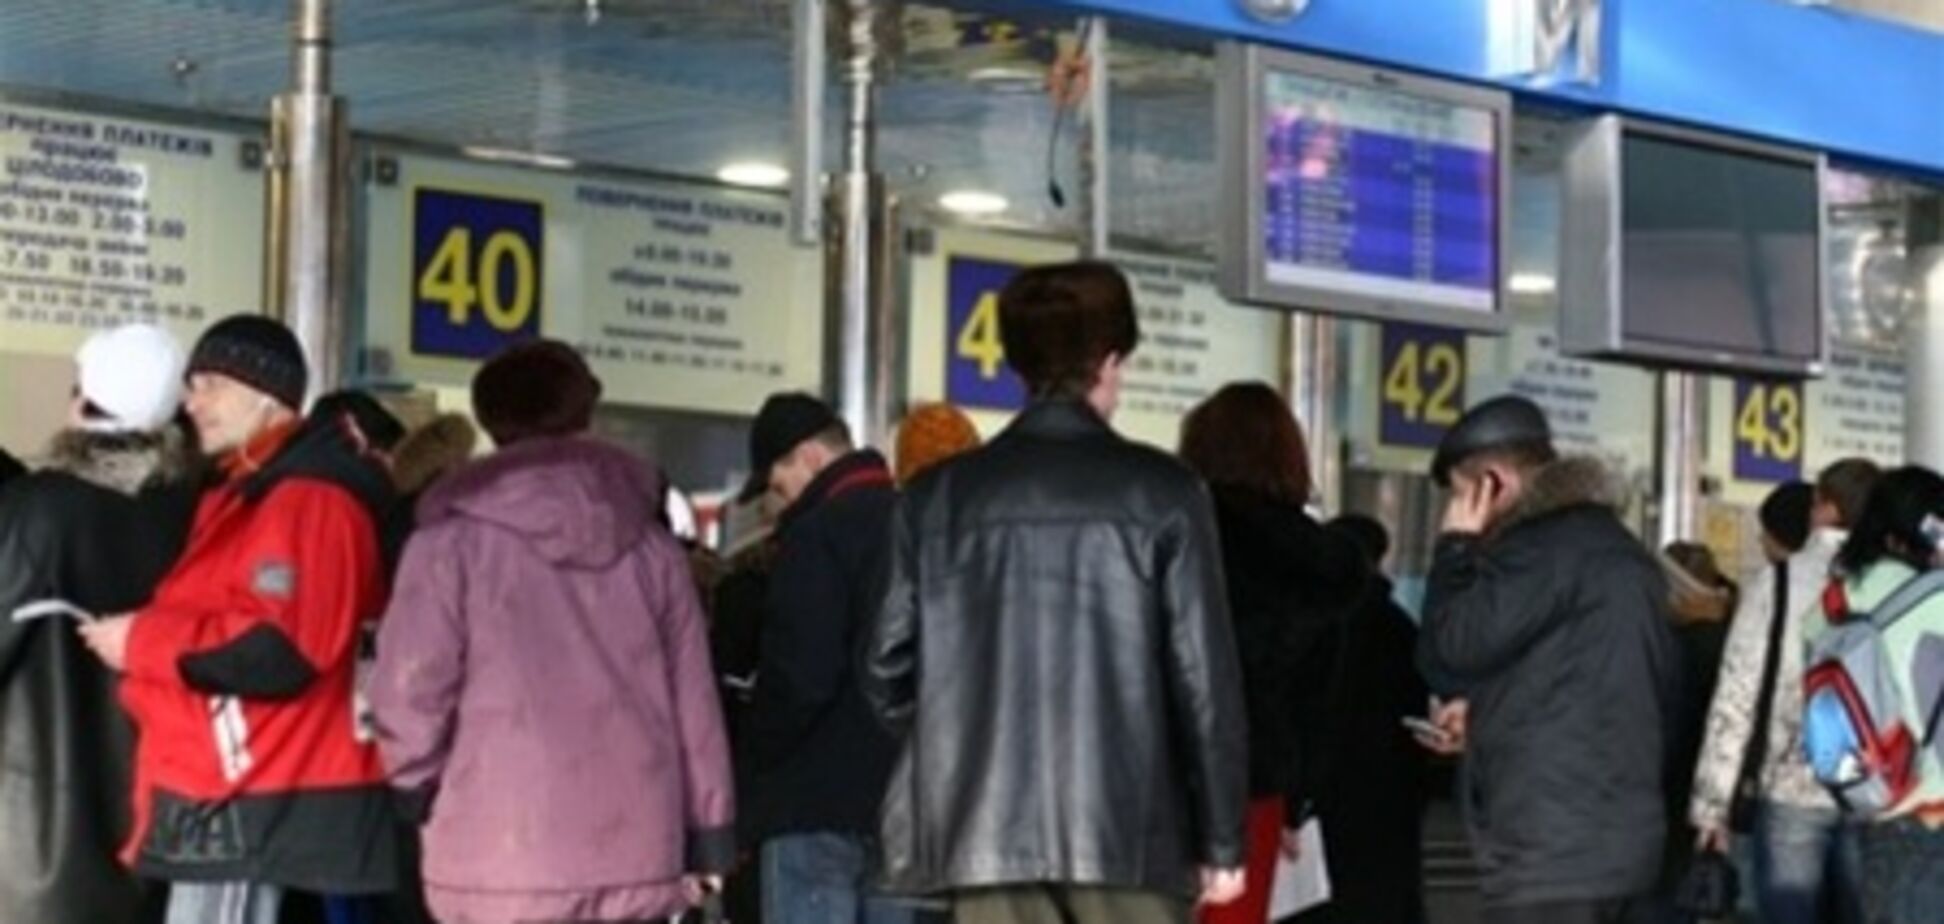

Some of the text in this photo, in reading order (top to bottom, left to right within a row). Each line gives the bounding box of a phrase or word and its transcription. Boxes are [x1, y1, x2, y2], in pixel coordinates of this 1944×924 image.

[418, 226, 535, 332] 40
[957, 289, 1004, 381] 4
[1386, 341, 1460, 424] 42
[1739, 383, 1799, 460] 43
